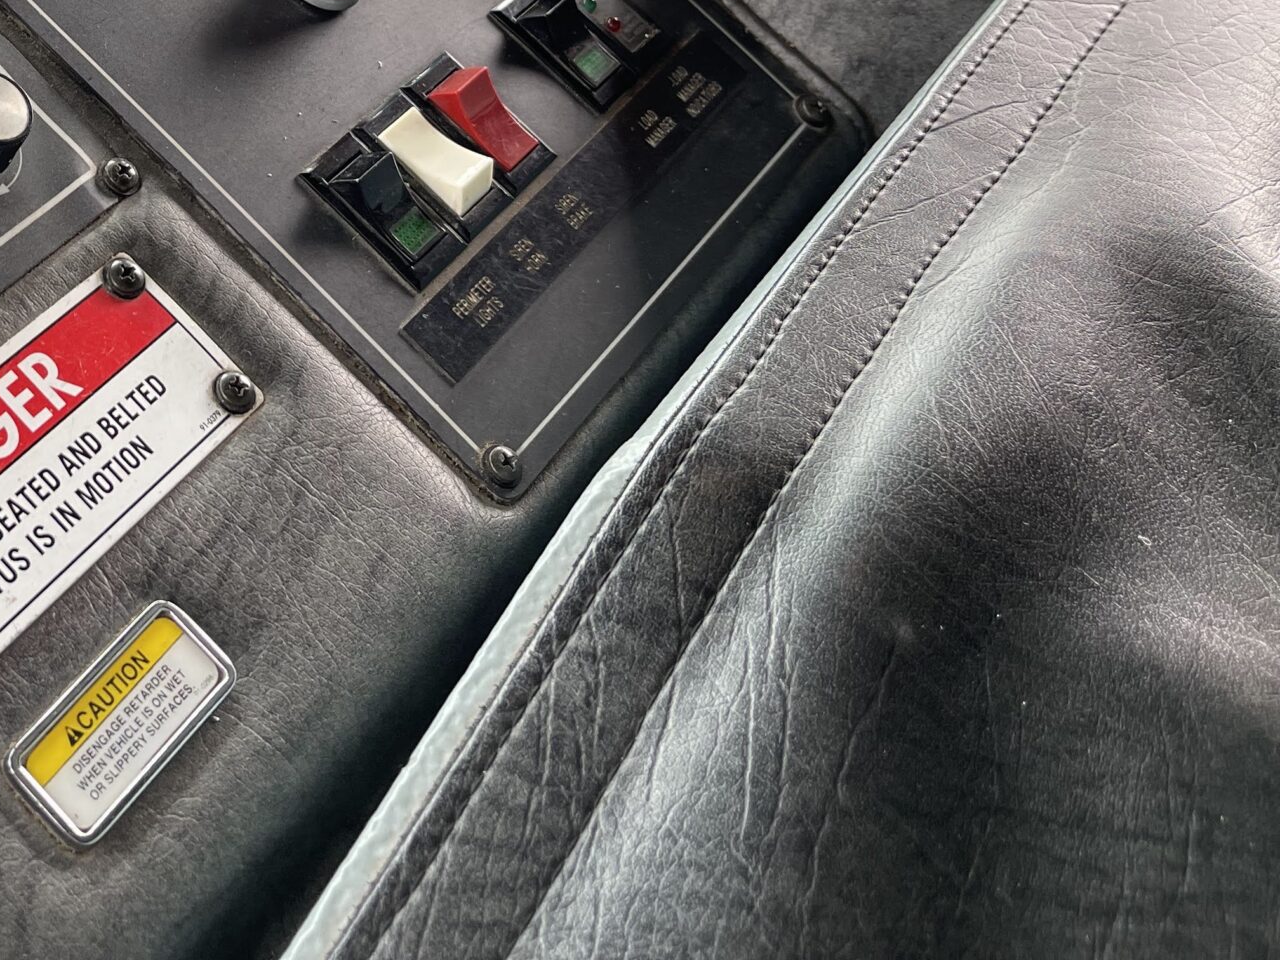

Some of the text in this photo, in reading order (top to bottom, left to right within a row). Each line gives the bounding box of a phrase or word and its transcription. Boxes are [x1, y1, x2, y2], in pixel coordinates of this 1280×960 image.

[638, 109, 658, 130] LOAD
[452, 276, 496, 319] PERIMETER
[474, 296, 504, 328] LIGHTS
[57, 431, 102, 477] AND
[96, 374, 167, 440] BELTED
[25, 525, 56, 556] IS
[50, 500, 83, 533] IN
[75, 435, 155, 511] MOTION
[73, 664, 172, 774] DISENGAGE RETARDER
[76, 649, 151, 730] CAUTION
[77, 669, 186, 792] WHEN VEHICLE IS ON WET
[90, 784, 107, 801] OR
[105, 736, 150, 784] SLIPPERY
